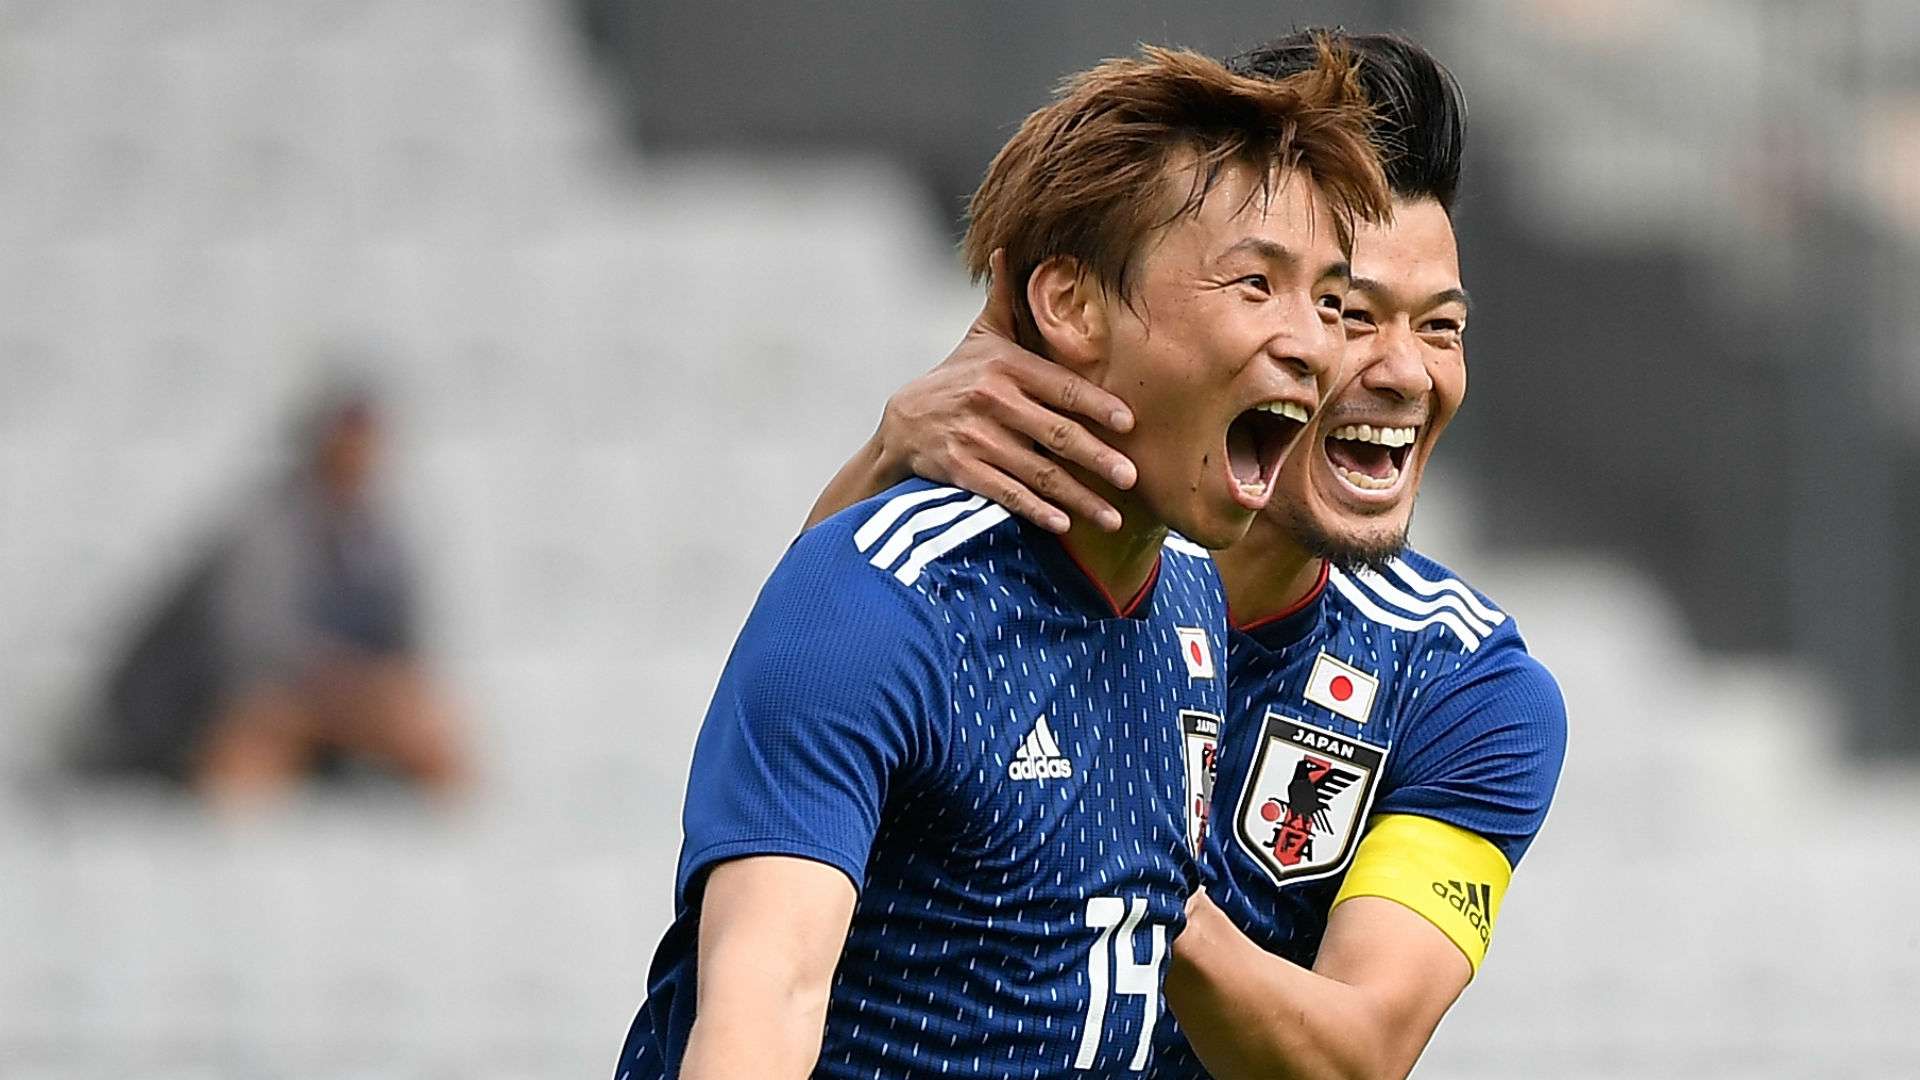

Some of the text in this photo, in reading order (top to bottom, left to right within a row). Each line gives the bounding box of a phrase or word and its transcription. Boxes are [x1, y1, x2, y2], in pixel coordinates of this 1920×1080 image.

[1292, 728, 1355, 759] JAPAN
[1008, 754, 1072, 780] adidas
[1262, 827, 1313, 862] JFA
[1431, 881, 1491, 956] adida
[1073, 896, 1167, 1072] 14
